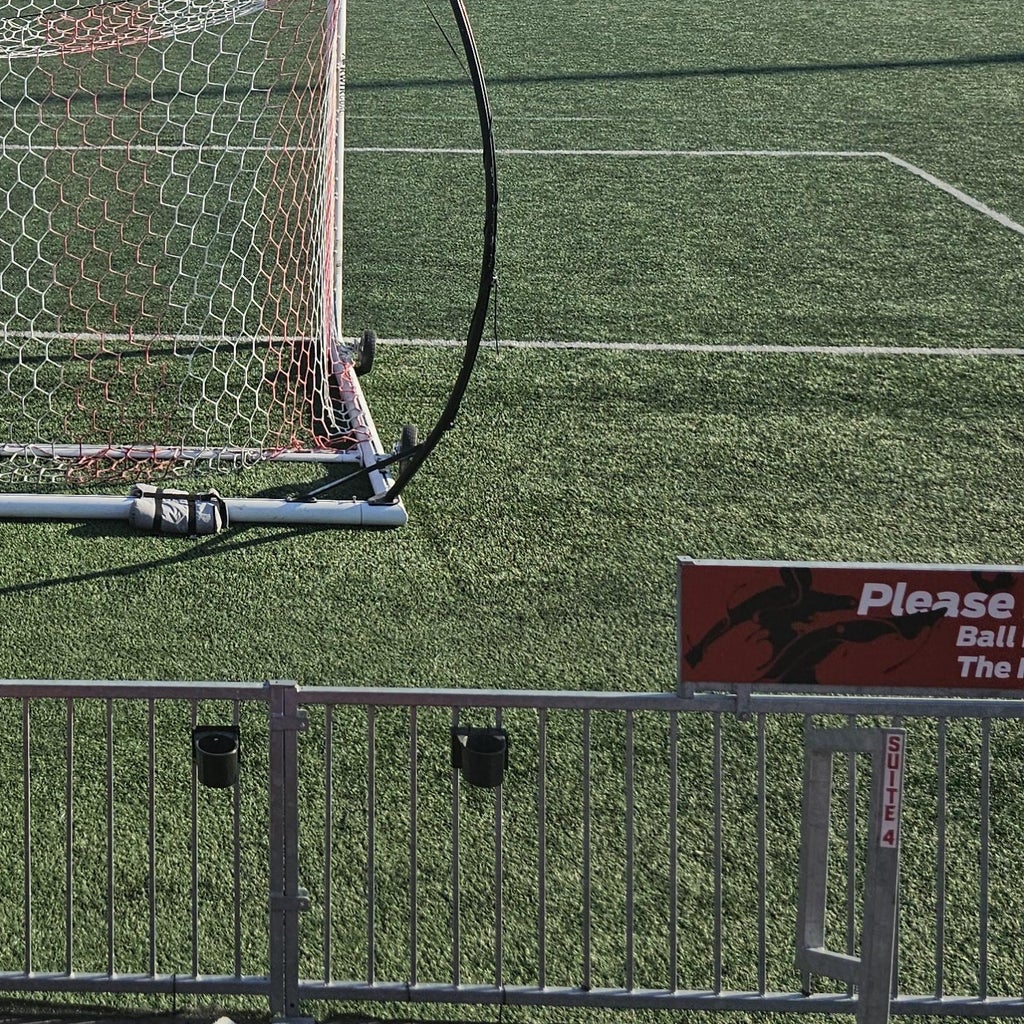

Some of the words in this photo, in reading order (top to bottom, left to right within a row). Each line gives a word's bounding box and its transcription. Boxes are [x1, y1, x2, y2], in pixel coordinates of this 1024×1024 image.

[857, 582, 1016, 619] Please
[955, 625, 1016, 648] Ball
[957, 655, 1011, 678] The
[885, 736, 900, 822] SUITE
[882, 830, 895, 846] 4
